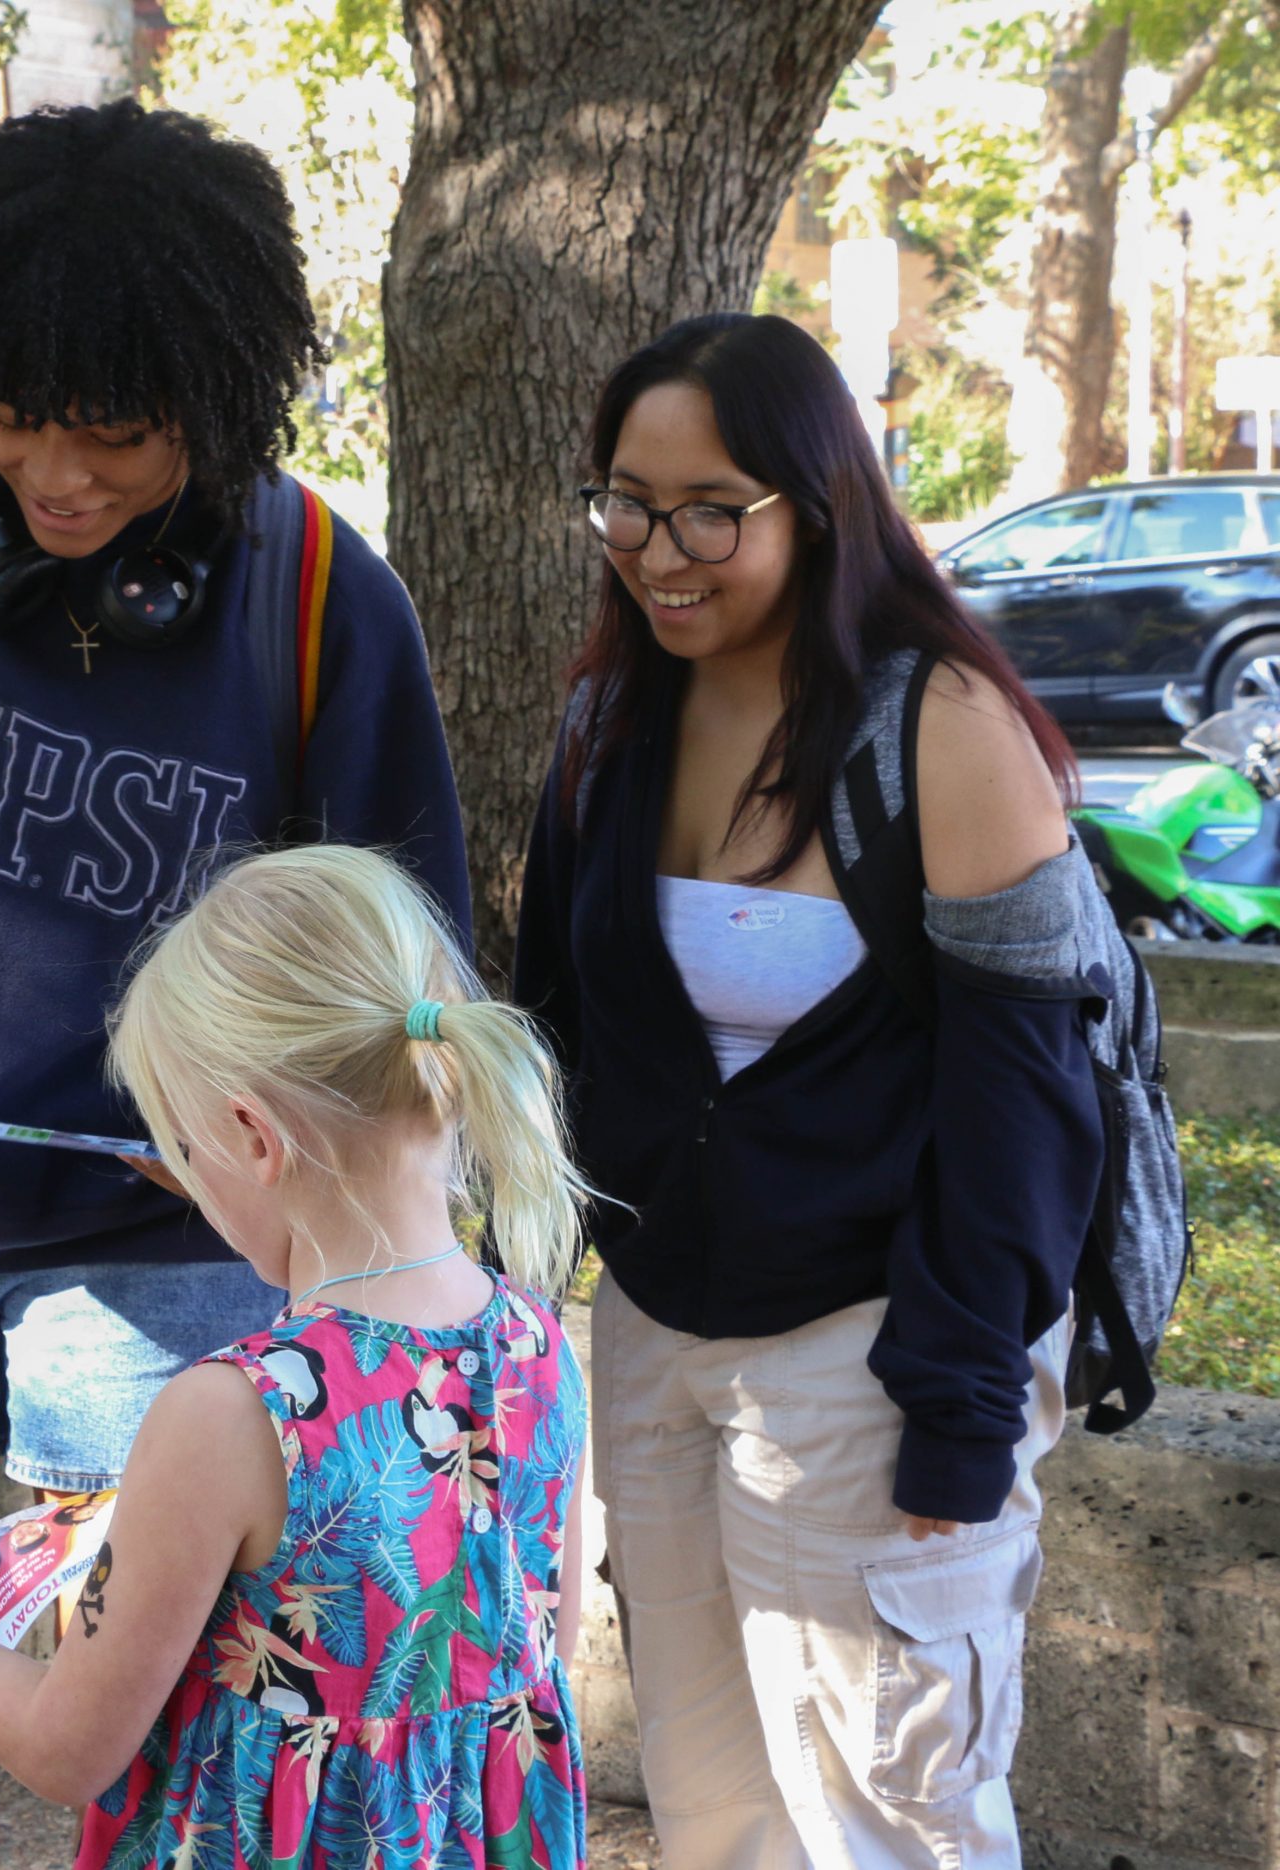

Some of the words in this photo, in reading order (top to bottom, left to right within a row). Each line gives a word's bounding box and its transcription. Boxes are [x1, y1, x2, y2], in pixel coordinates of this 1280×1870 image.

[755, 907, 780, 915] Voted
[32, 1558, 55, 1572] Vote
[14, 1571, 34, 1587] FOR
[5, 1578, 61, 1641] TODAY!
